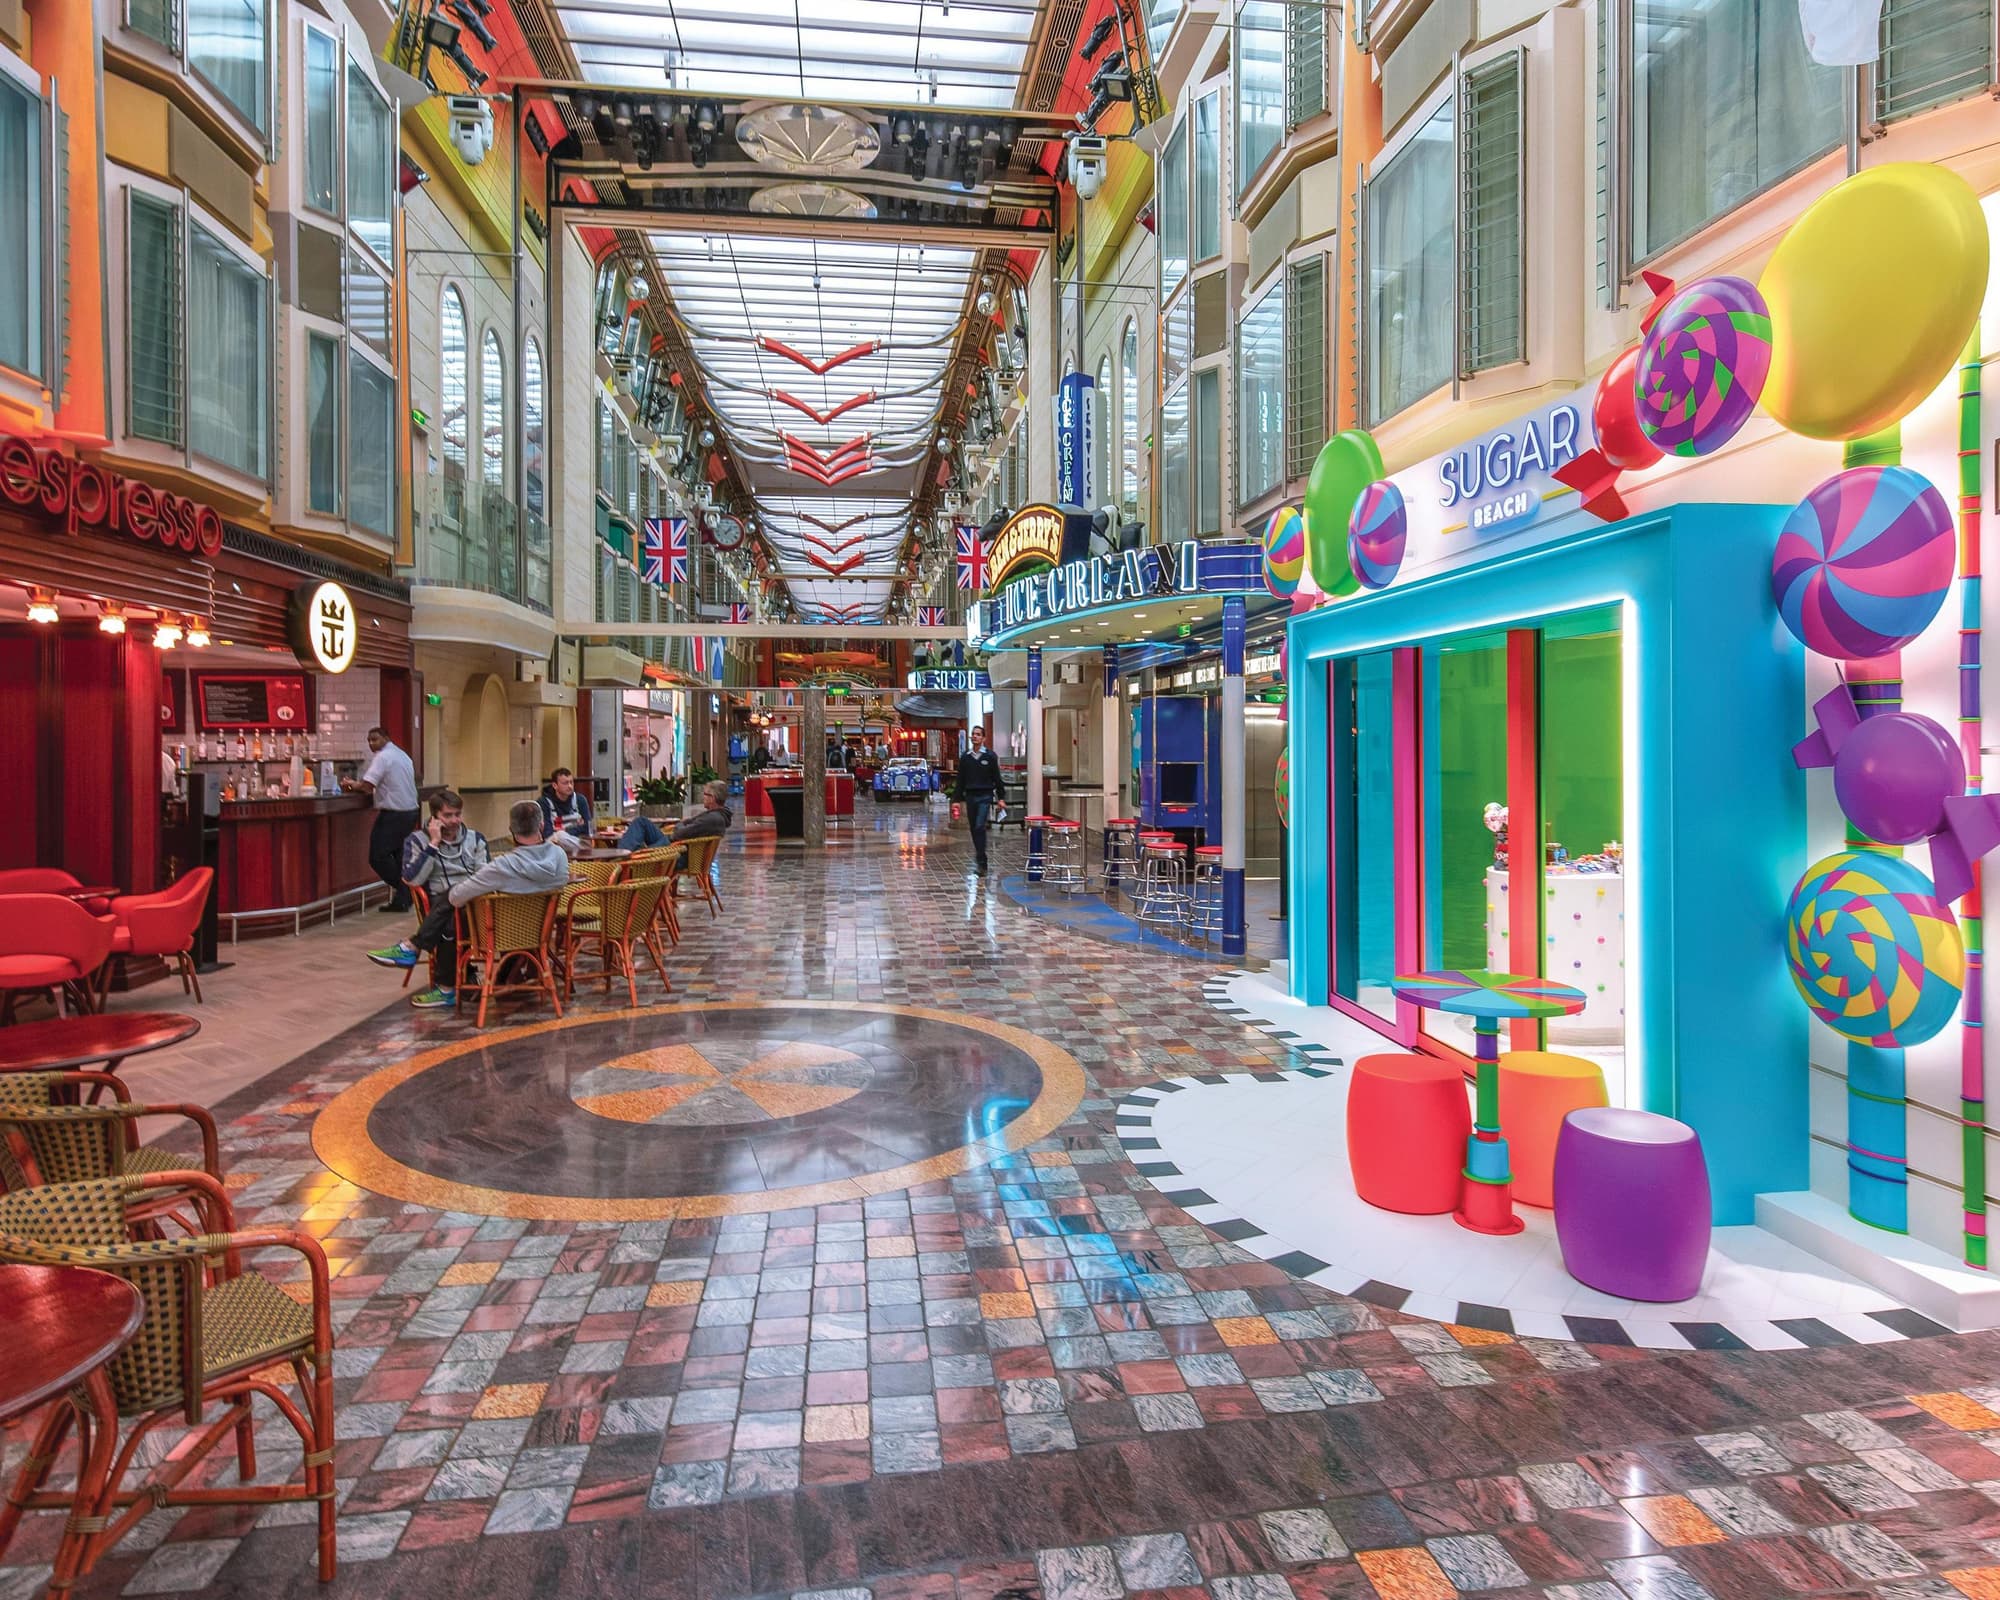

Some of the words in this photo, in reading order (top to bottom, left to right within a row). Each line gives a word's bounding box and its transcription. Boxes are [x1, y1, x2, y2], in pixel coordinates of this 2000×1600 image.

[1062, 384, 1074, 429] ICE
[1439, 405, 1580, 508] SUGAR
[0, 439, 223, 558] espresso
[1473, 491, 1528, 529] BEACH
[989, 533, 1011, 585] BEN
[1017, 515, 1061, 556] JERRY'S
[1005, 574, 1041, 625] ICE
[1046, 540, 1198, 616] CREAM
